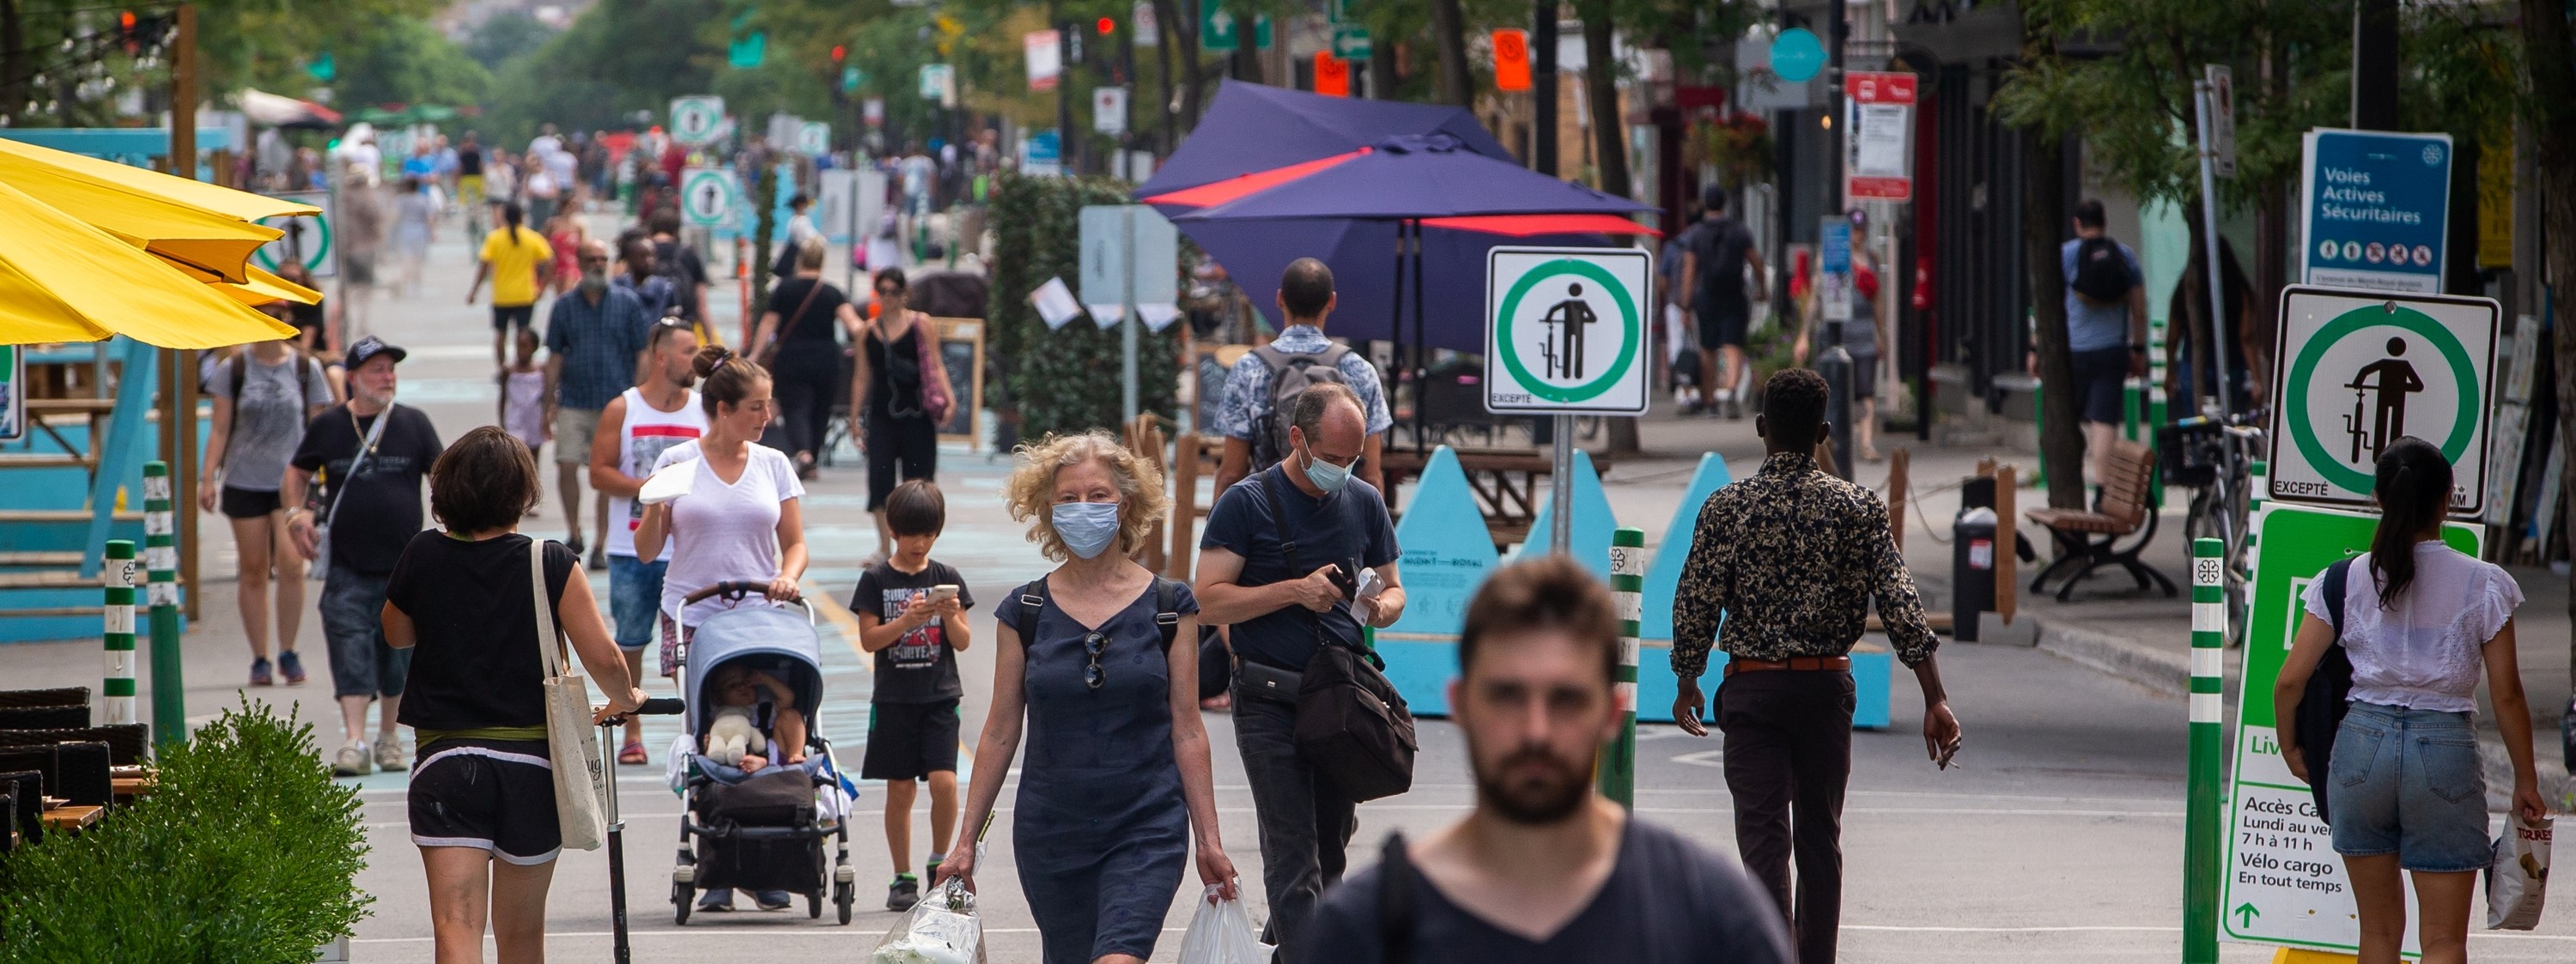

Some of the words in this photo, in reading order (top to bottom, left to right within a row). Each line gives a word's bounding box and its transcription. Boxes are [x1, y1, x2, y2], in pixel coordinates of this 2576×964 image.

[2324, 167, 2371, 185] Voies
[2322, 185, 2385, 203] Actives
[2321, 203, 2421, 225] Sécuritaires
[2275, 480, 2329, 496] EXCEPTÉ
[2245, 797, 2293, 815] Accès
[2244, 815, 2284, 831] Lundi
[2288, 822, 2306, 834] au
[2242, 833, 2251, 845] 7
[2255, 833, 2264, 846] h
[2269, 835, 2277, 848] à
[2283, 837, 2297, 849] 11
[2303, 838, 2312, 851] h
[2240, 852, 2279, 870] Vélo
[2283, 860, 2333, 877] cargo
[2239, 871, 2257, 884] En
[2261, 874, 2292, 888] tout
[2296, 877, 2342, 894] temps
